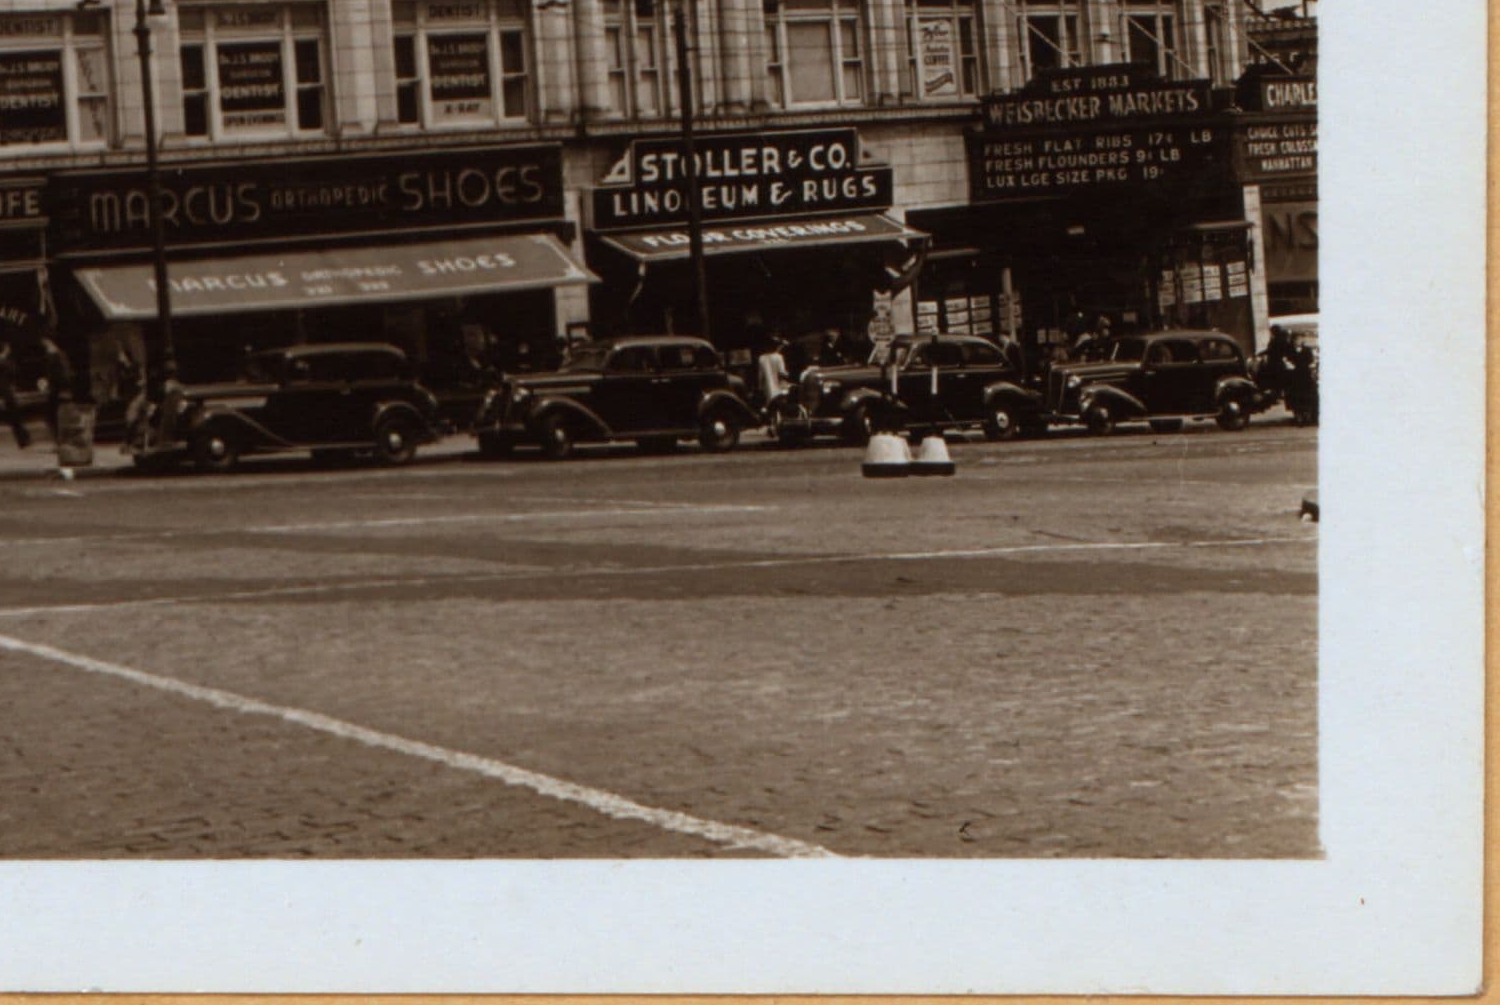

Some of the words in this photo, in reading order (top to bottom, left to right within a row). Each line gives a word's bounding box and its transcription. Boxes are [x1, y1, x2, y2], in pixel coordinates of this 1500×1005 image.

[1051, 77, 1083, 94] EST
[1108, 88, 1199, 117] MARKETS
[984, 141, 1033, 156] FRESH
[1043, 138, 1082, 153] FLAT
[1190, 128, 1213, 144] LB
[787, 150, 802, 169] &
[809, 142, 851, 171] CO.
[985, 158, 1034, 173] FRESH
[1038, 151, 1130, 170] FLOUNDERS
[1159, 147, 1182, 162] LB
[986, 173, 1016, 189] LUX
[1020, 172, 1050, 187] LGE
[1056, 169, 1090, 185] SIZE
[90, 182, 261, 233] MARCUS
[399, 165, 544, 211] SHOES
[613, 184, 759, 217] LINOEUM
[770, 181, 793, 205] &
[802, 175, 878, 202] RUGS
[415, 252, 517, 275] SHOES
